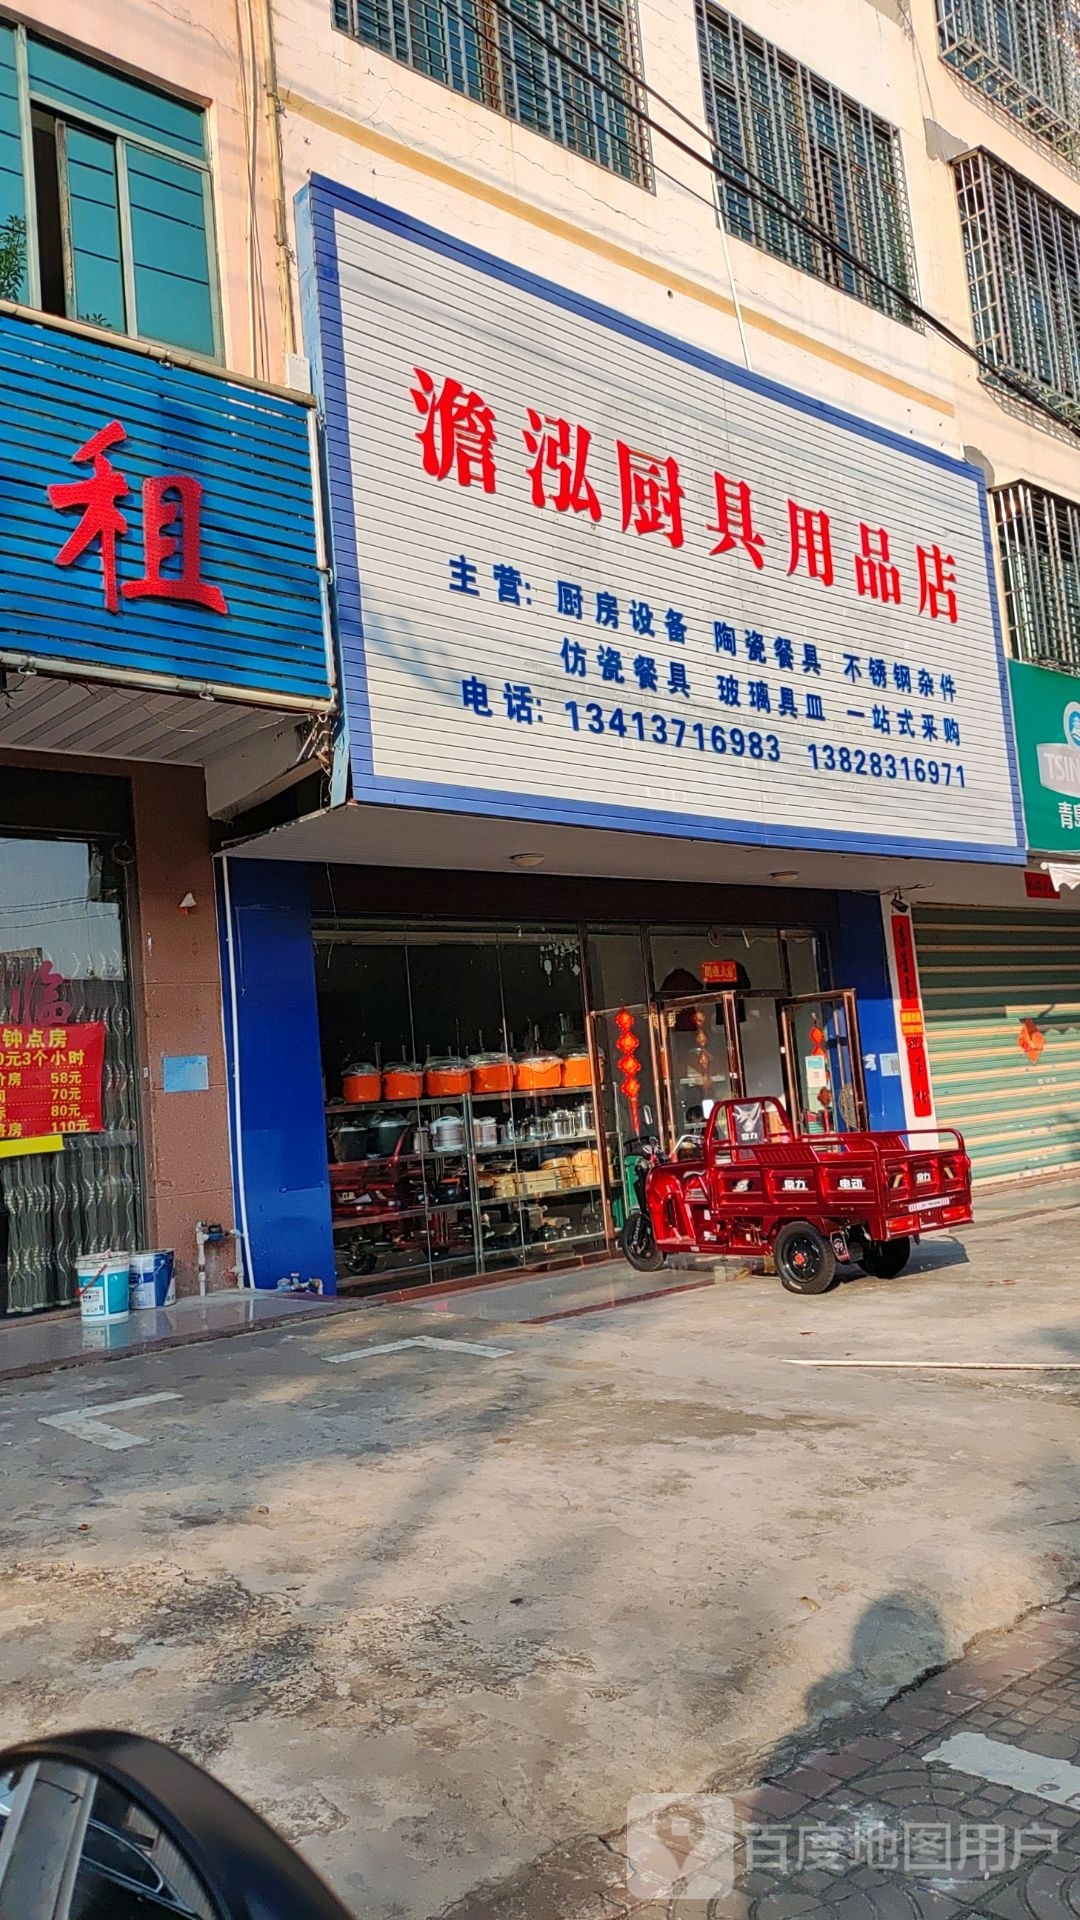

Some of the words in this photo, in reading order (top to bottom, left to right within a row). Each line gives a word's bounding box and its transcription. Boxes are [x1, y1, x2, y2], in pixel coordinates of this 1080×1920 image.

[46, 419, 229, 615] 租
[409, 367, 958, 625] 澹泓厨具用品店
[557, 580, 688, 643] 厨房设备
[713, 621, 821, 676] 陶瓷餐具
[843, 653, 957, 703] 不锈钢杂件
[559, 638, 691, 698] 仿瓷餐具
[716, 674, 826, 721] 玻璃具皿
[847, 704, 960, 746] 一站式采购
[564, 700, 781, 762] 13413716983
[807, 743, 965, 788] 13828316971
[2, 1028, 67, 1049] 钟点房
[50, 1071, 82, 1085] 58元
[51, 1087, 82, 1101] 70元
[51, 1104, 81, 1118] 80元
